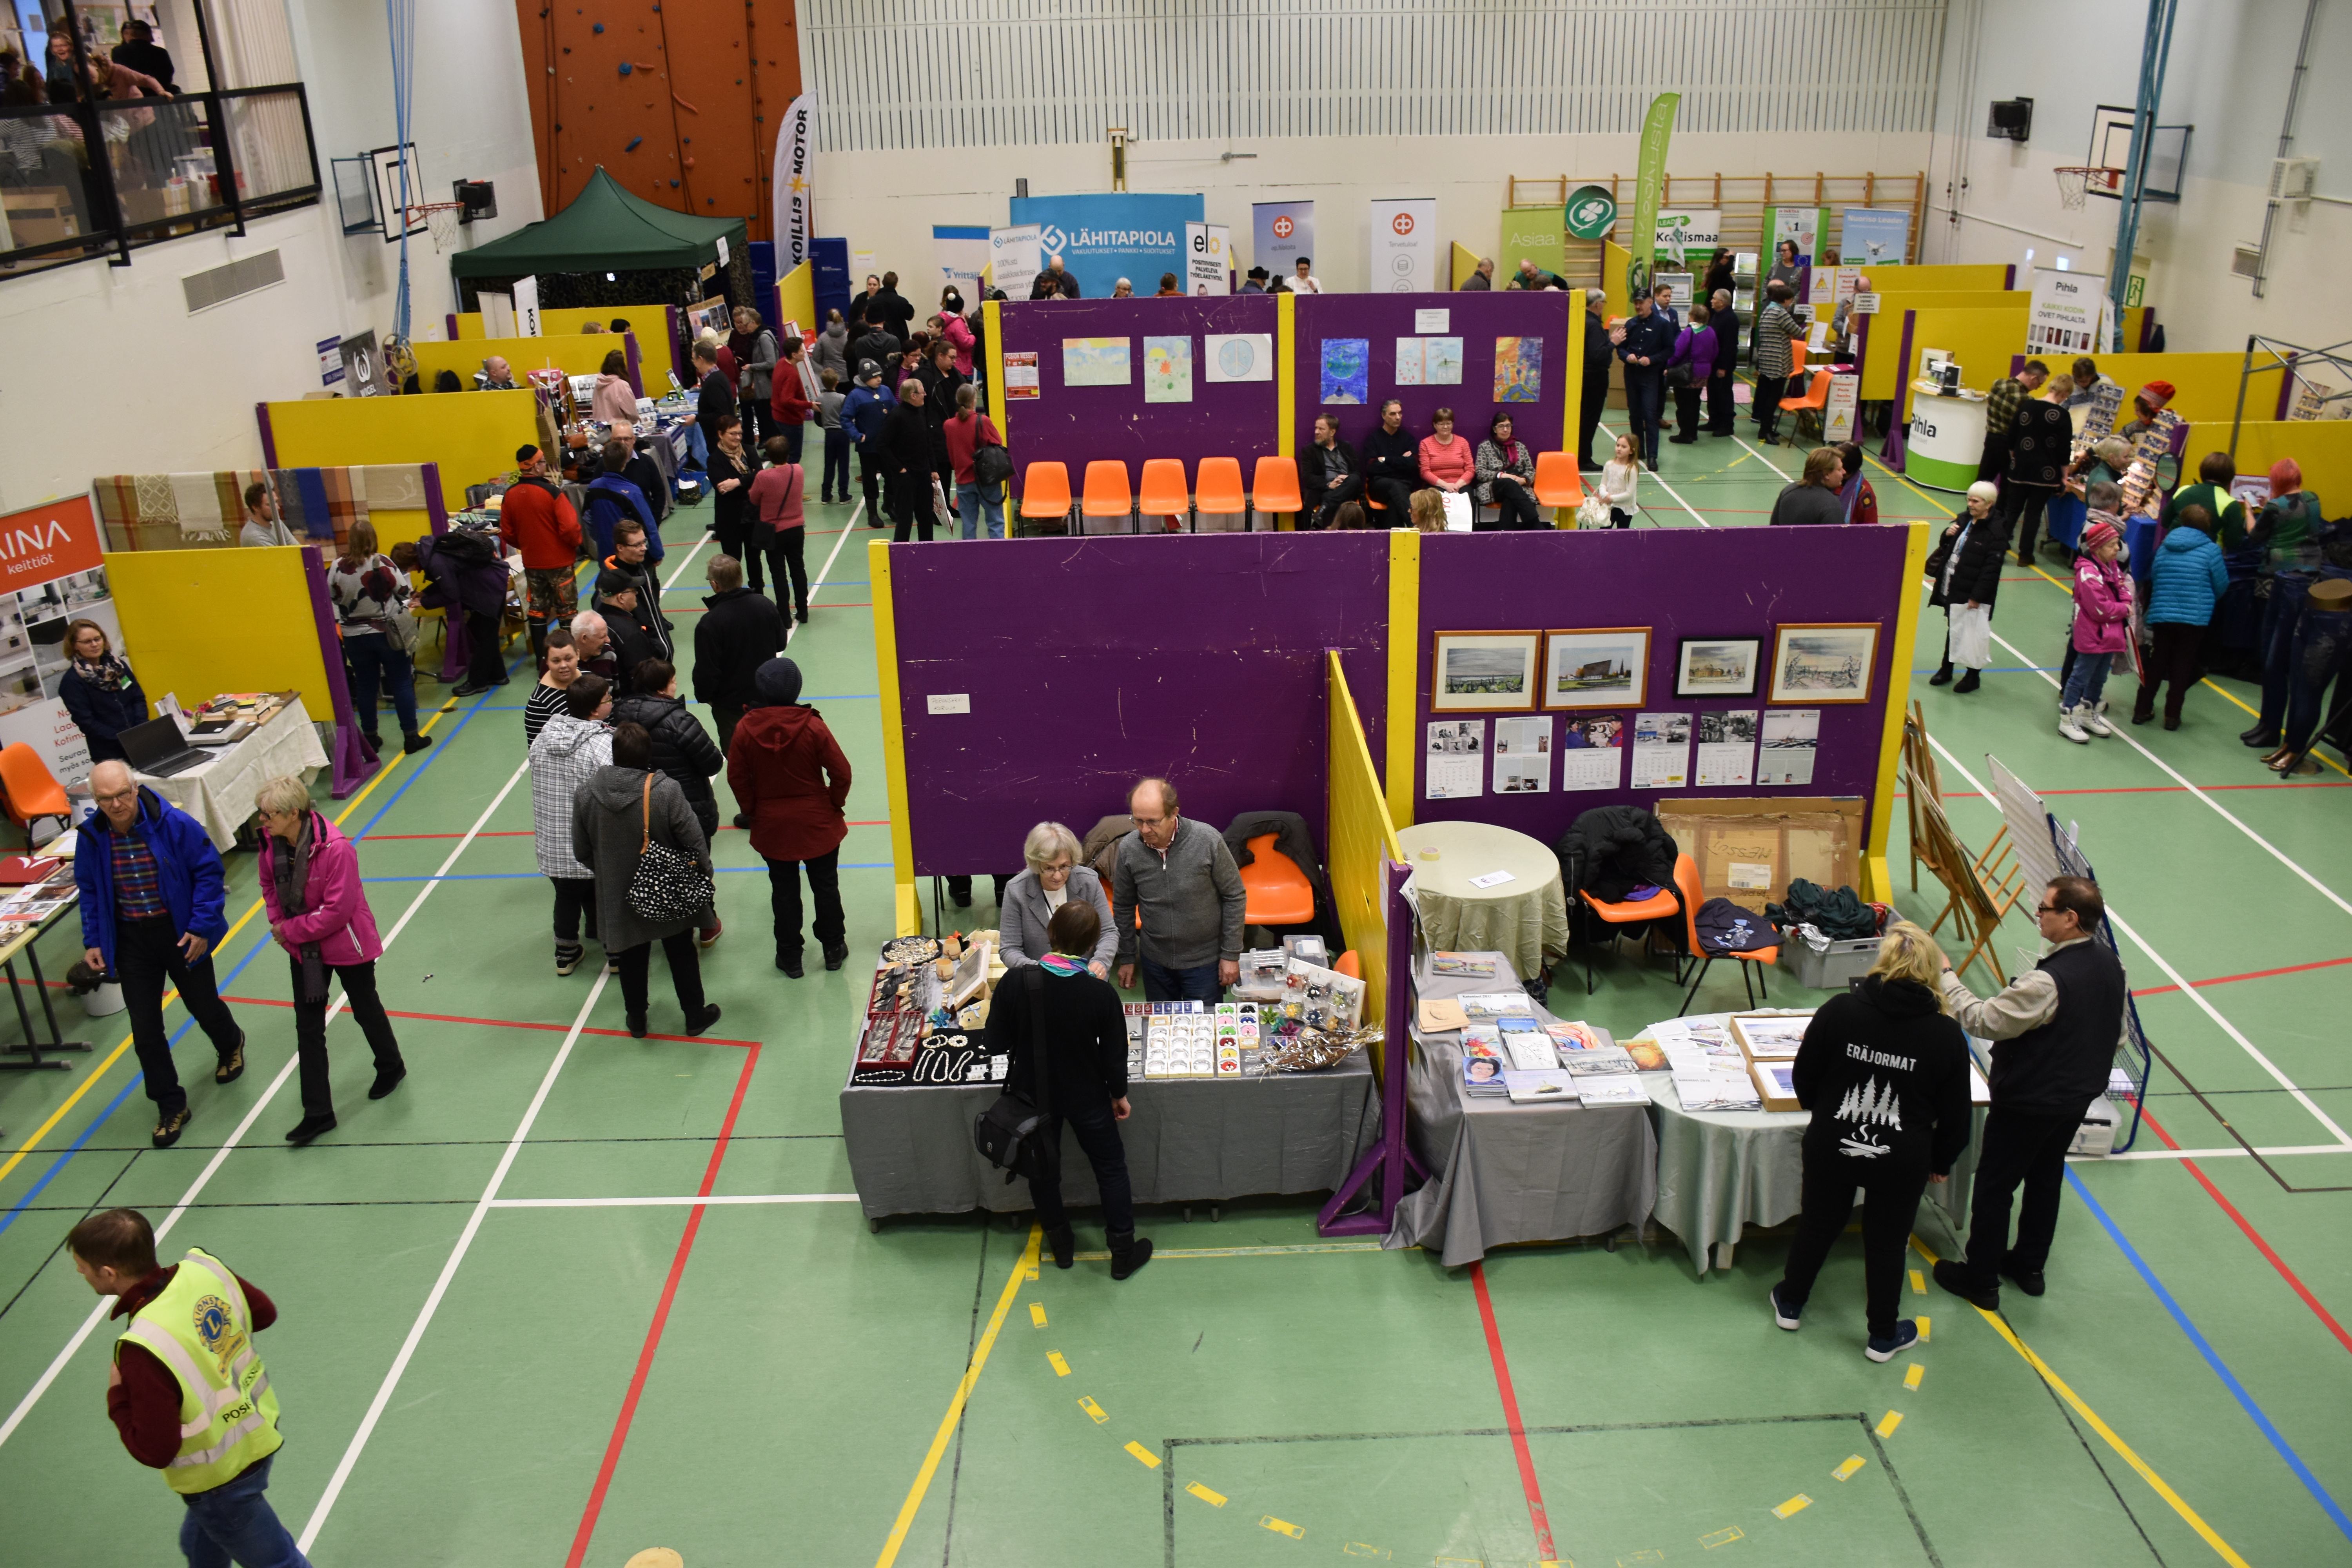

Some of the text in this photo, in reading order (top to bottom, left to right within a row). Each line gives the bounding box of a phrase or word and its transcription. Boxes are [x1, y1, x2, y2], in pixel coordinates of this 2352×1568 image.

[791, 109, 808, 265] KOILLIS MOTOR
[1659, 217, 1684, 226] LEADR
[1793, 222, 1800, 231] 1
[1004, 234, 1037, 244] LÄHITAPIOLA
[1071, 228, 1176, 247] LÄHITAPIOLA
[1194, 225, 1221, 254] elo
[1510, 232, 1559, 247] Asiaa.
[1192, 259, 1221, 268] POSITIIVISESTI
[2056, 281, 2078, 293] Pihla
[2042, 302, 2085, 314] KAIKKI KODIN
[2056, 313, 2086, 324] PIHLALTA
[7, 553, 54, 575] keittiöt
[57, 709, 71, 719] No
[59, 748, 87, 762] Seuraa
[60, 762, 79, 773] myös
[1846, 1043, 1917, 1072] ERÄJORMAT
[195, 1296, 214, 1322] LIONS
[206, 1314, 221, 1336] L
